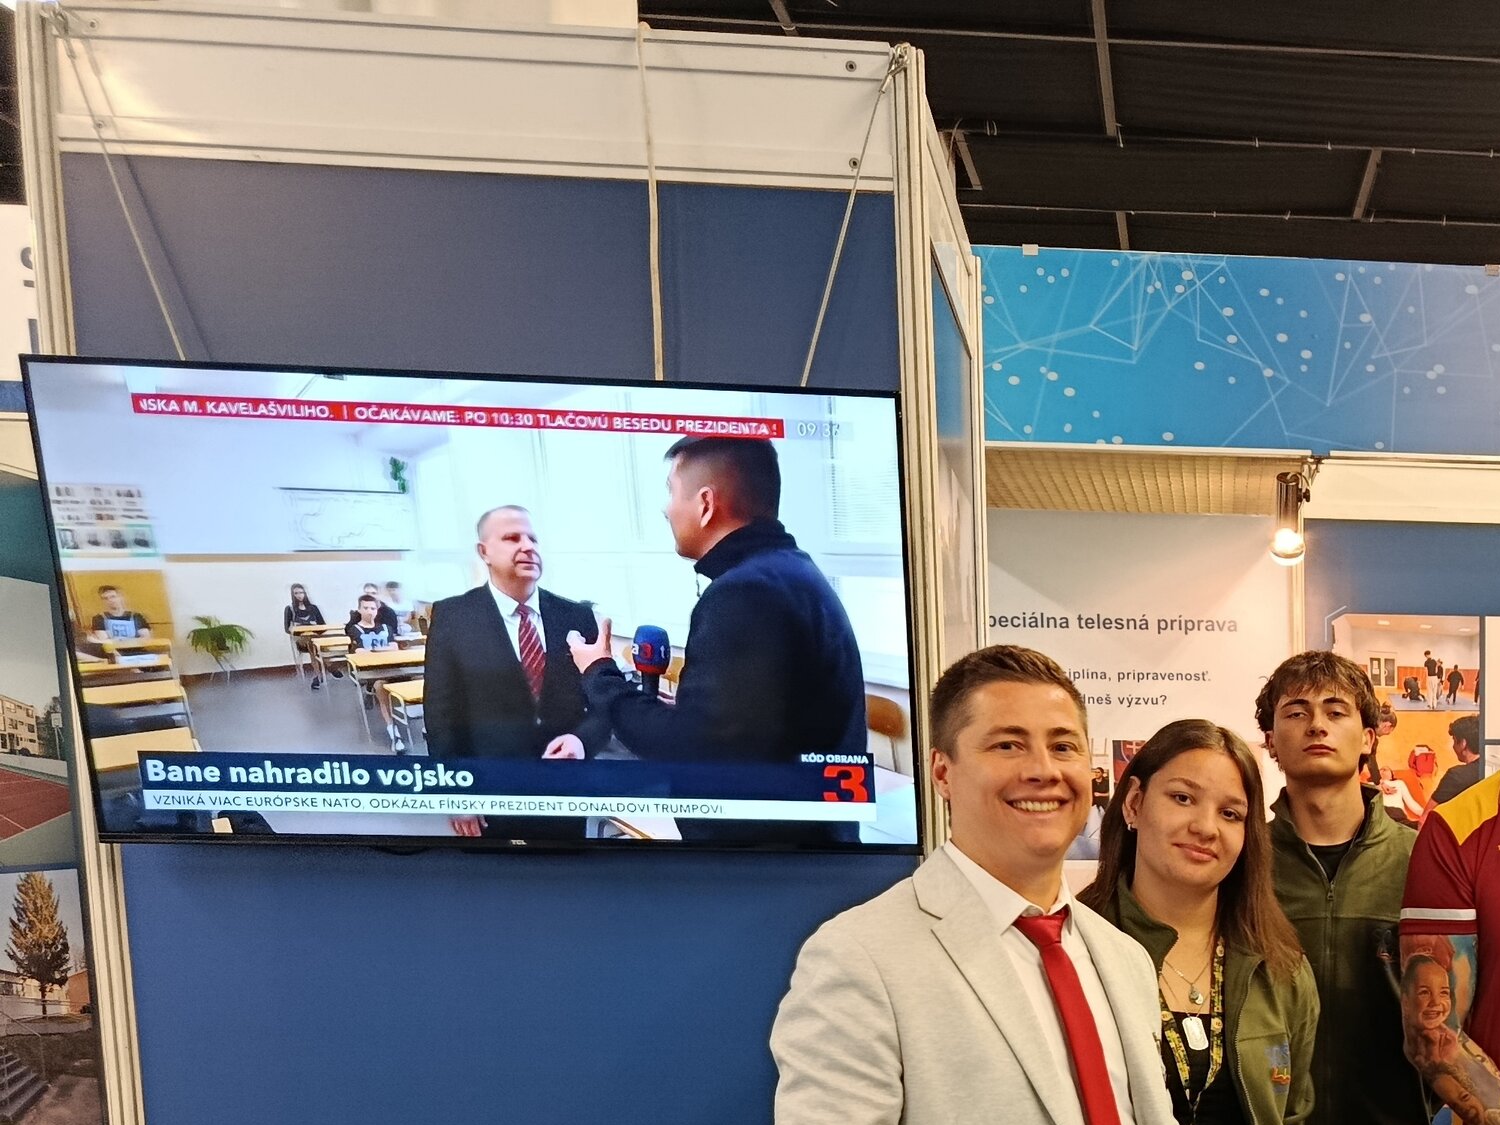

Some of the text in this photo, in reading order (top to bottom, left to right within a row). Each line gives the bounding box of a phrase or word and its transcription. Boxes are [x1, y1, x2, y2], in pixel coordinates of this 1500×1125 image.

[184, 400, 203, 413] M.
[206, 400, 334, 419] KAVELAŠVILIHO.
[355, 403, 460, 424] OČAKÁVAME:
[463, 411, 487, 424] PO
[492, 412, 533, 426] 10:30
[537, 412, 609, 430] TLAČOVÚ
[613, 416, 672, 432] BESEDU
[676, 419, 769, 437] PREZIDENTA
[1077, 613, 1149, 631] telesná
[1157, 615, 1238, 634] príprava
[1067, 669, 1112, 682] iplína,
[1118, 693, 1167, 708] výzvu?
[800, 752, 868, 765] KÓD OBRANA
[145, 759, 474, 791] Bane nahradilo vojsko
[822, 765, 868, 803] 3
[153, 793, 205, 806] VZNIKÁ
[208, 796, 242, 807] VIAC
[246, 795, 318, 808] EURÓPSKE
[322, 798, 365, 811] NATO,
[369, 796, 435, 810] ODKÁZAL
[439, 798, 486, 811] FÍNSKY
[491, 800, 564, 813] PREZIDENT
[568, 801, 650, 815] DONALDOVI
